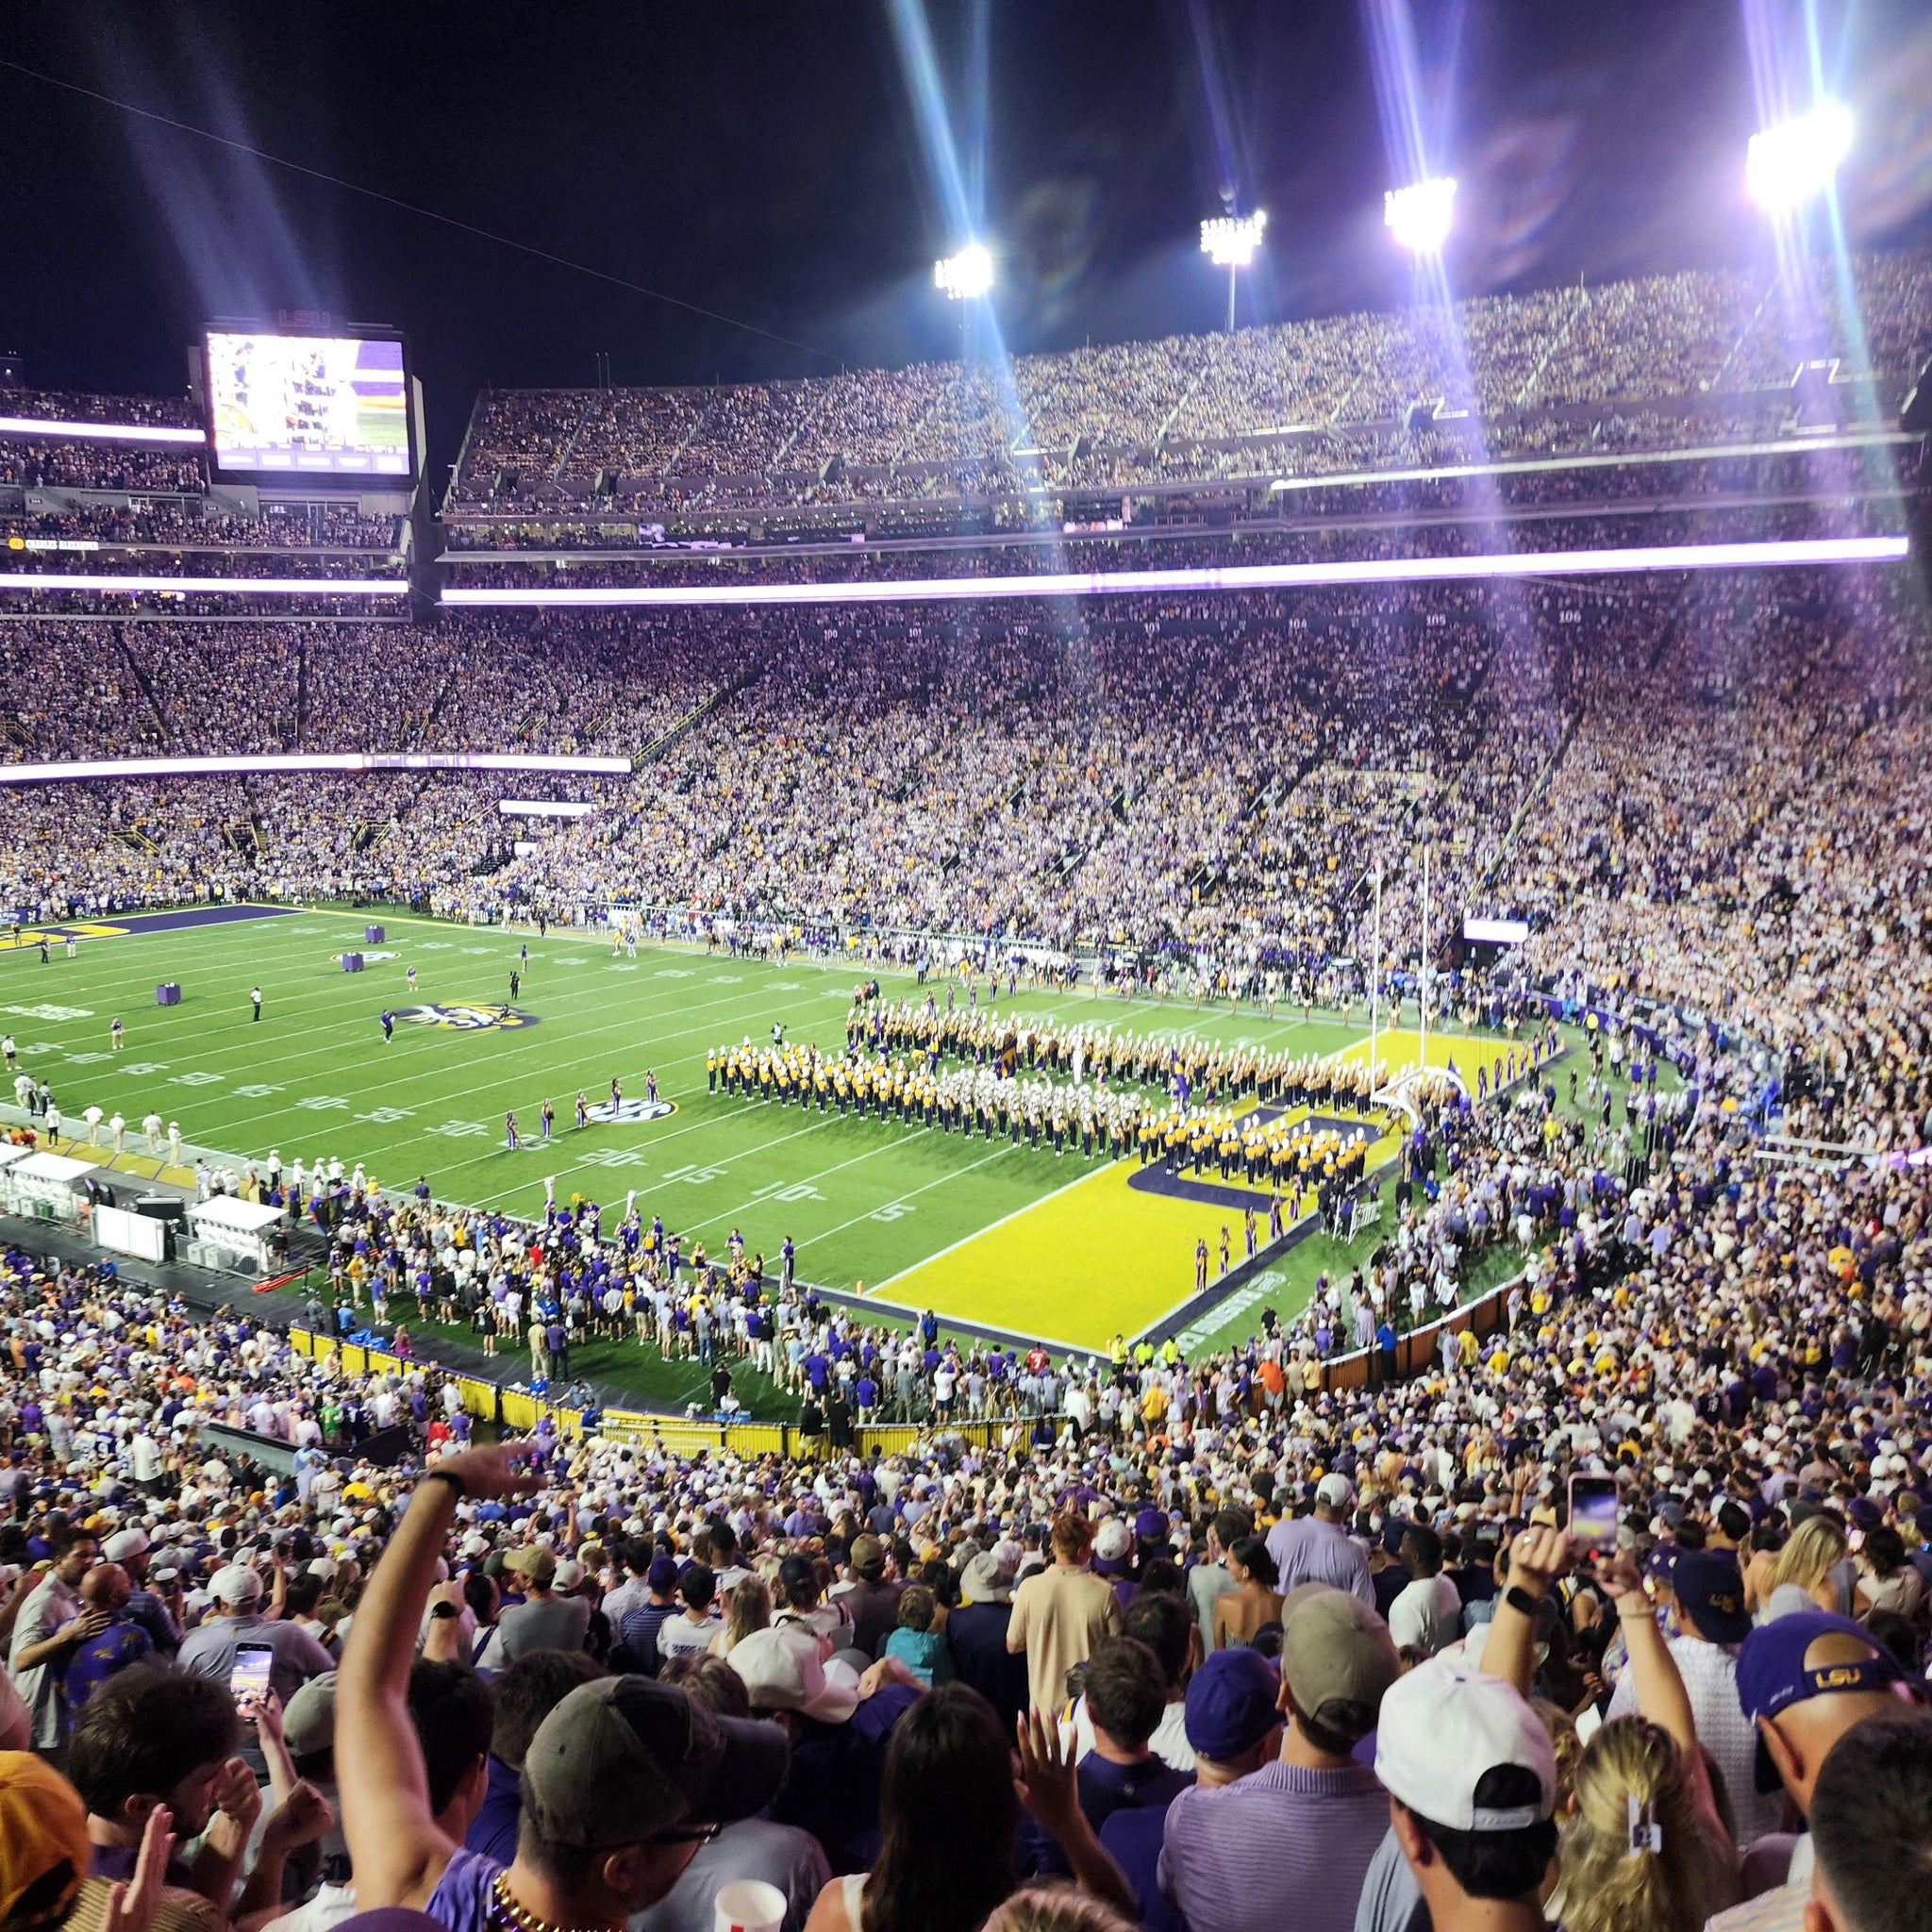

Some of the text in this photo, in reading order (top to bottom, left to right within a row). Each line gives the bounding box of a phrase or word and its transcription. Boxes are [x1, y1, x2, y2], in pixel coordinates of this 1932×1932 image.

[277, 308, 330, 328] LSU
[1289, 618, 1307, 629] 104
[1425, 613, 1446, 626] 105
[1558, 610, 1581, 624] 106
[824, 629, 839, 640] 100
[908, 627, 923, 638] 101
[1014, 626, 1029, 637] 102
[1144, 622, 1160, 633] 103
[575, 1147, 644, 1167] 20
[661, 1164, 728, 1184] 15
[751, 1181, 819, 1202] 10
[870, 1203, 917, 1222] 5
[1815, 1668, 1862, 1689] LSU
